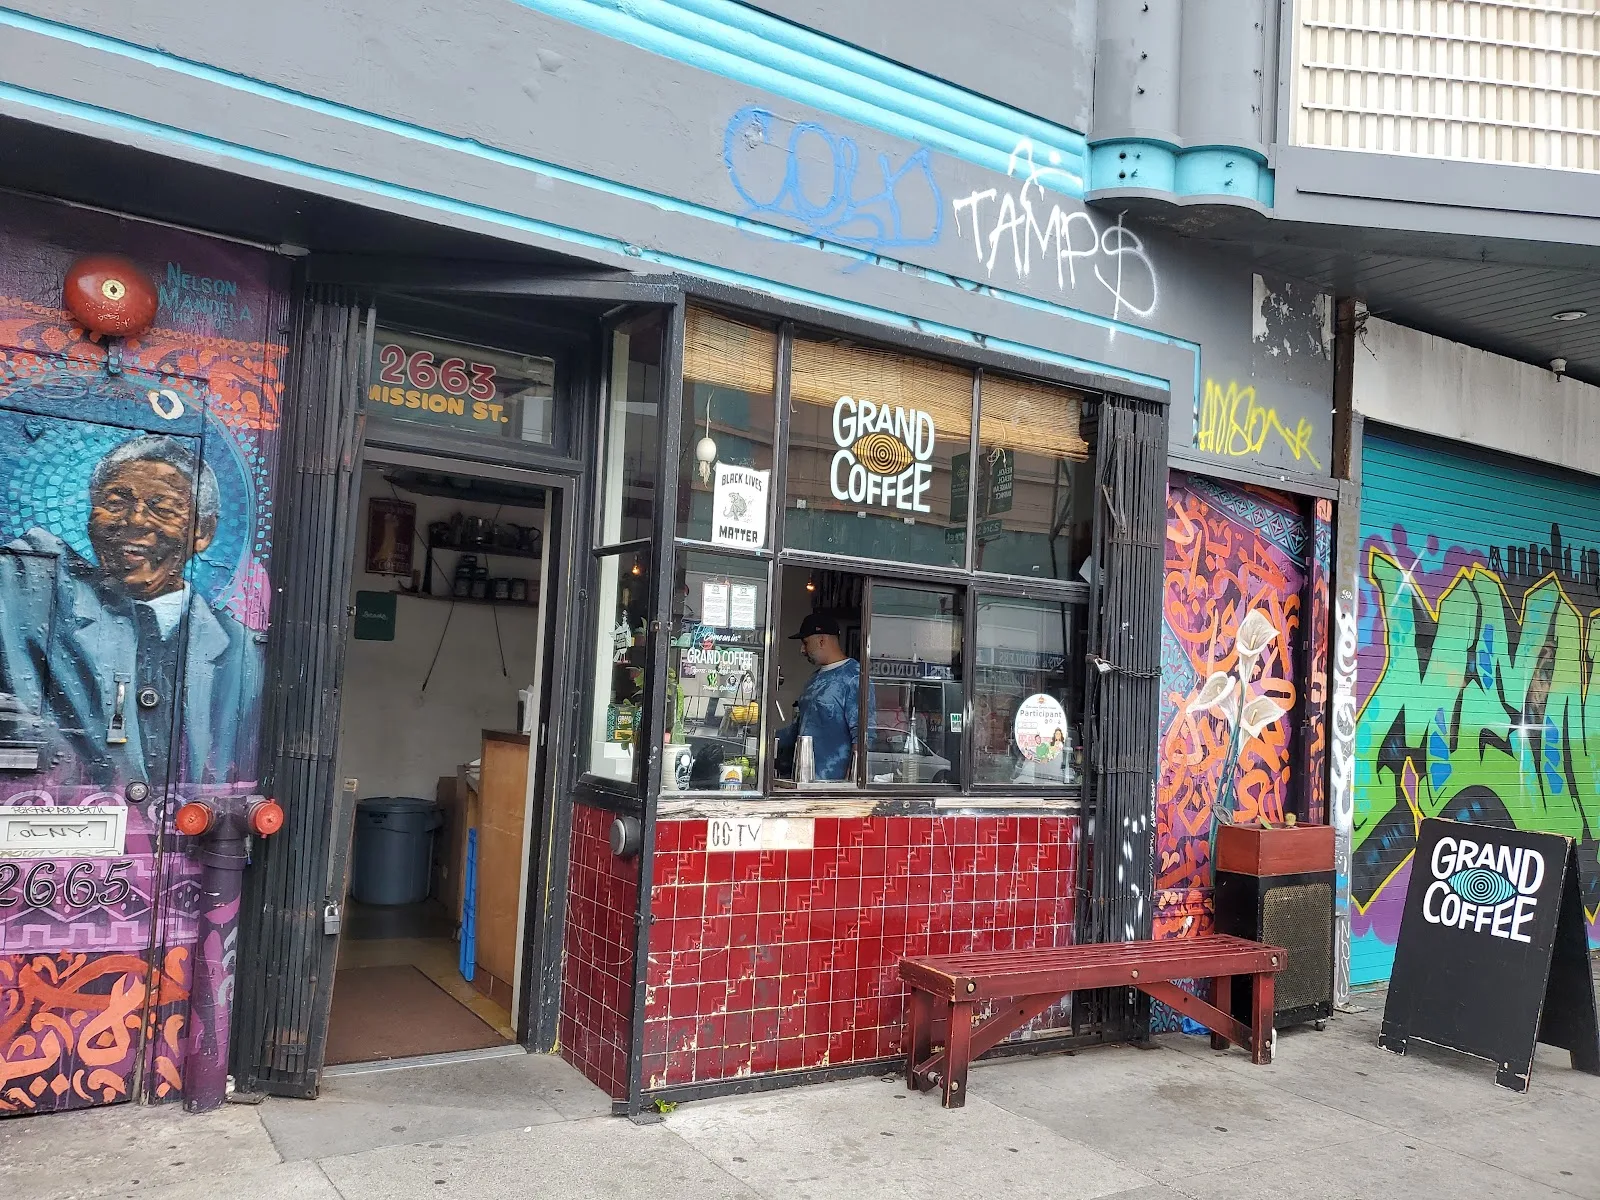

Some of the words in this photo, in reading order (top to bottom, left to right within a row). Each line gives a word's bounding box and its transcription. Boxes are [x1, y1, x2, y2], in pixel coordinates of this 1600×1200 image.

[380, 344, 496, 401] 2663
[369, 385, 464, 416] MISSION
[472, 402, 509, 423] ST.
[832, 396, 935, 461] GRAND
[722, 473, 743, 486] BLACK
[745, 474, 762, 492] LIVES
[830, 449, 933, 513] COFFEE
[719, 525, 758, 543] MATTER
[688, 648, 720, 664] GRAND
[722, 650, 754, 668] COFFEE
[1020, 710, 1062, 718] Participant
[711, 820, 762, 848] CCTV
[0, 860, 135, 908] 2665
[1431, 836, 1545, 895] GRAND
[1423, 881, 1538, 944] COFFEE
